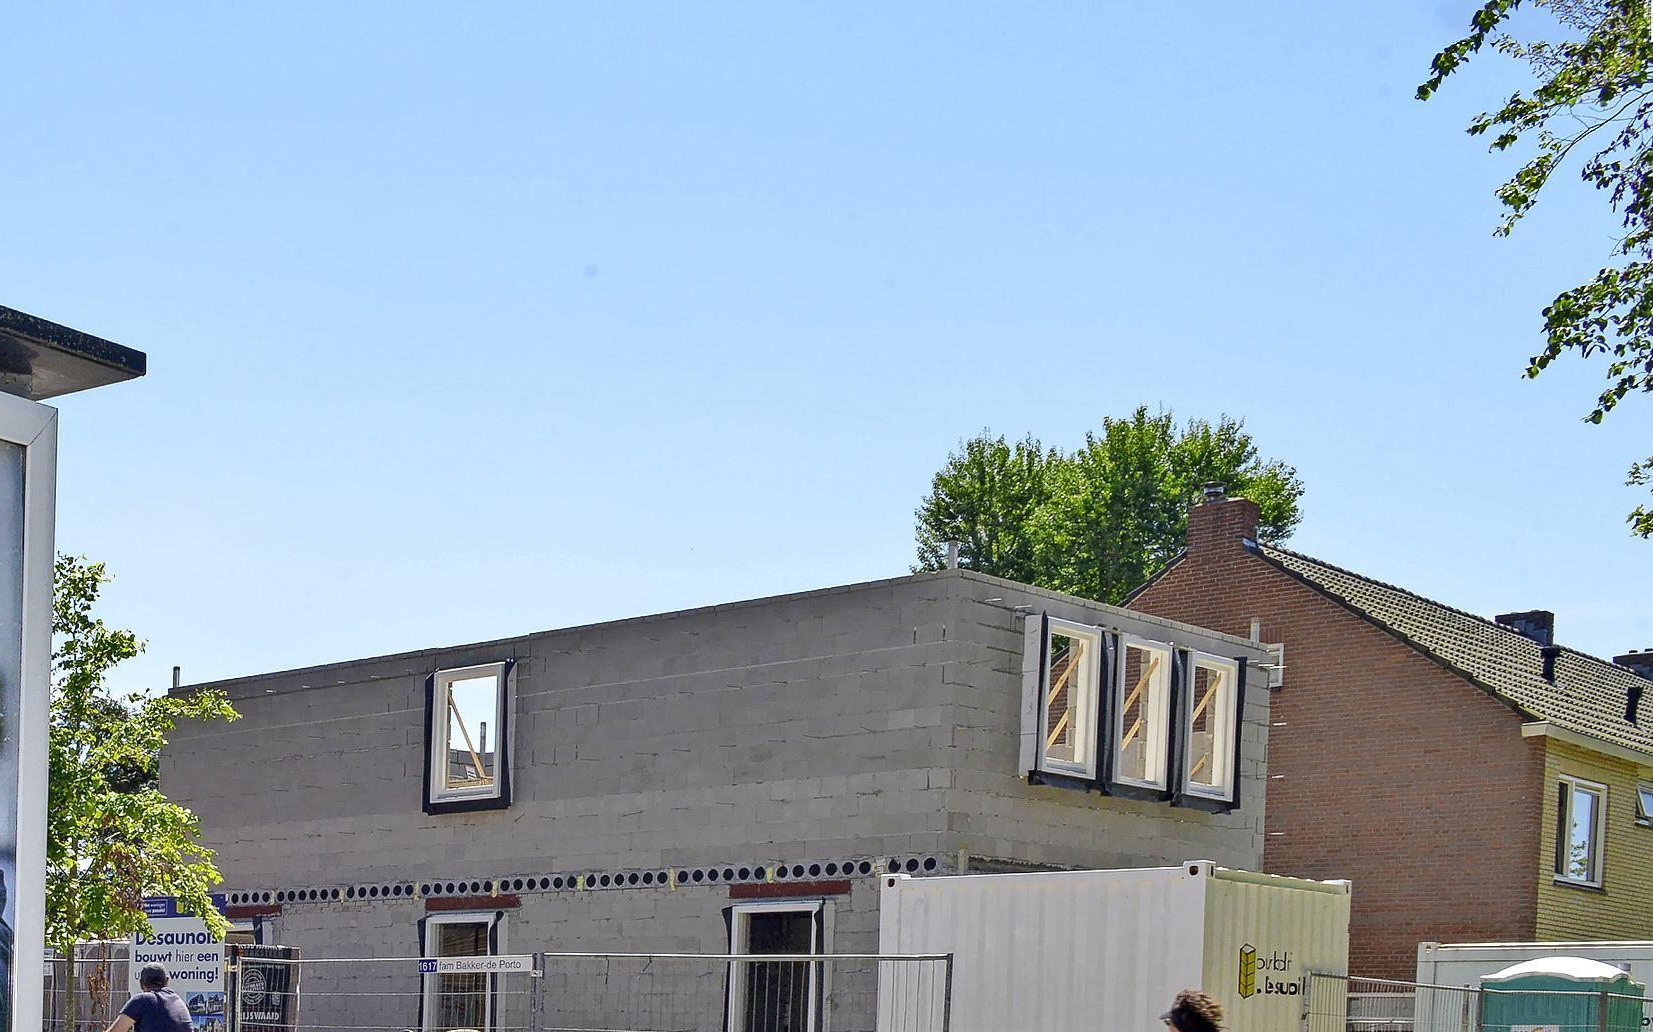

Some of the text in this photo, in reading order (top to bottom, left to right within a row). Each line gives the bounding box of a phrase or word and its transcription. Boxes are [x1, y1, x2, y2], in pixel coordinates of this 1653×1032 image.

[135, 950, 219, 963] bouwt hier een
[419, 959, 521, 971] 1617 fam Bakker-de Porto
[169, 966, 219, 983] woning!
